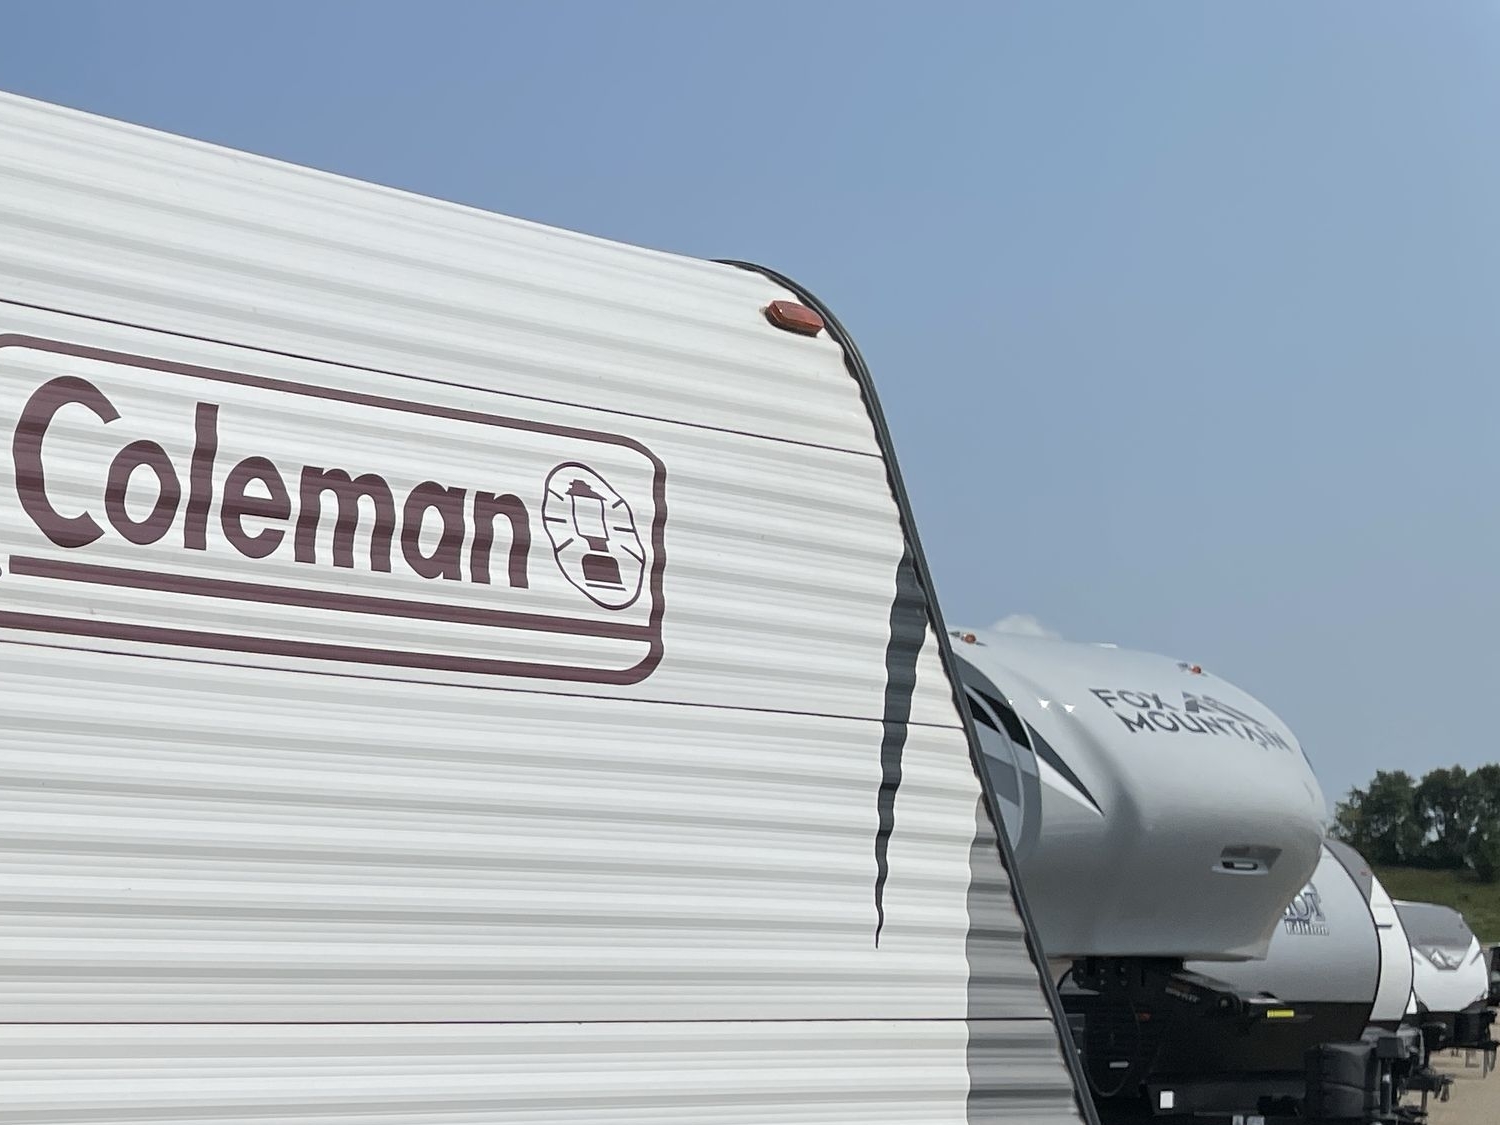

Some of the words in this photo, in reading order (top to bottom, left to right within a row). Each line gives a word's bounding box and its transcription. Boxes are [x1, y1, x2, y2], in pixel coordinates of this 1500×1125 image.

[12, 375, 531, 590] Coleman
[1088, 687, 1178, 712] FOX
[1113, 710, 1295, 754] MOUNTAIN
